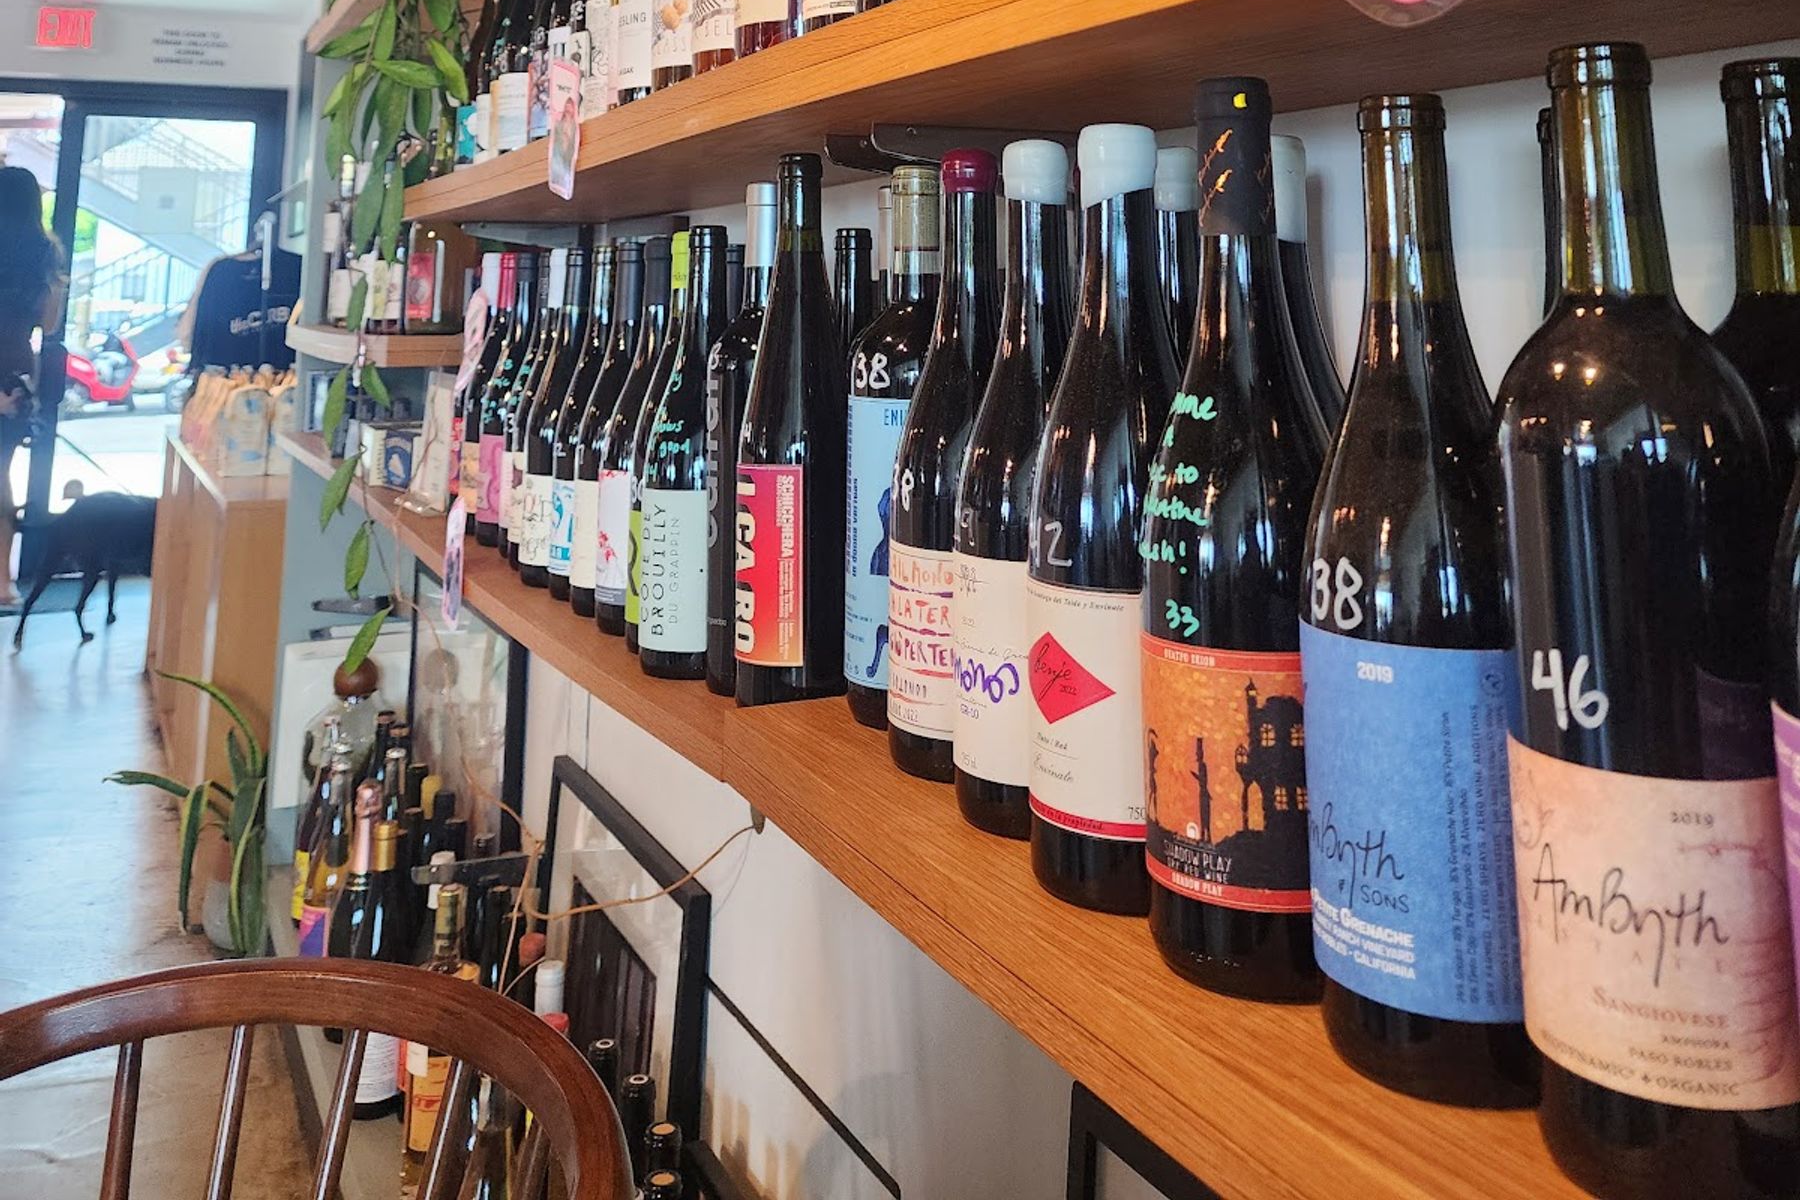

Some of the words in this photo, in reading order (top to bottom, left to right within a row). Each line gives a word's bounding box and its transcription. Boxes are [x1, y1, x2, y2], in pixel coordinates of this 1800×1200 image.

[855, 352, 891, 390] 38
[1175, 462, 1199, 485] to
[781, 475, 794, 558] SCHICCHERA
[651, 503, 666, 637] BROUILLY
[668, 518, 680, 594] GRAPPIN
[1311, 557, 1364, 630] 38
[1166, 600, 1199, 637] 33
[1356, 661, 1394, 683] 2019
[1531, 648, 1610, 731] 46
[1475, 802, 1486, 833] ZERO
[1202, 853, 1232, 873] PLAY
[1477, 841, 1488, 885] SPRAYS
[1202, 881, 1223, 897] PLAY
[1360, 884, 1410, 914] SONS
[1628, 1046, 1669, 1067] PASO
[1673, 1055, 1734, 1073] ROBLES
[1655, 1075, 1740, 1097] ORGANIC
